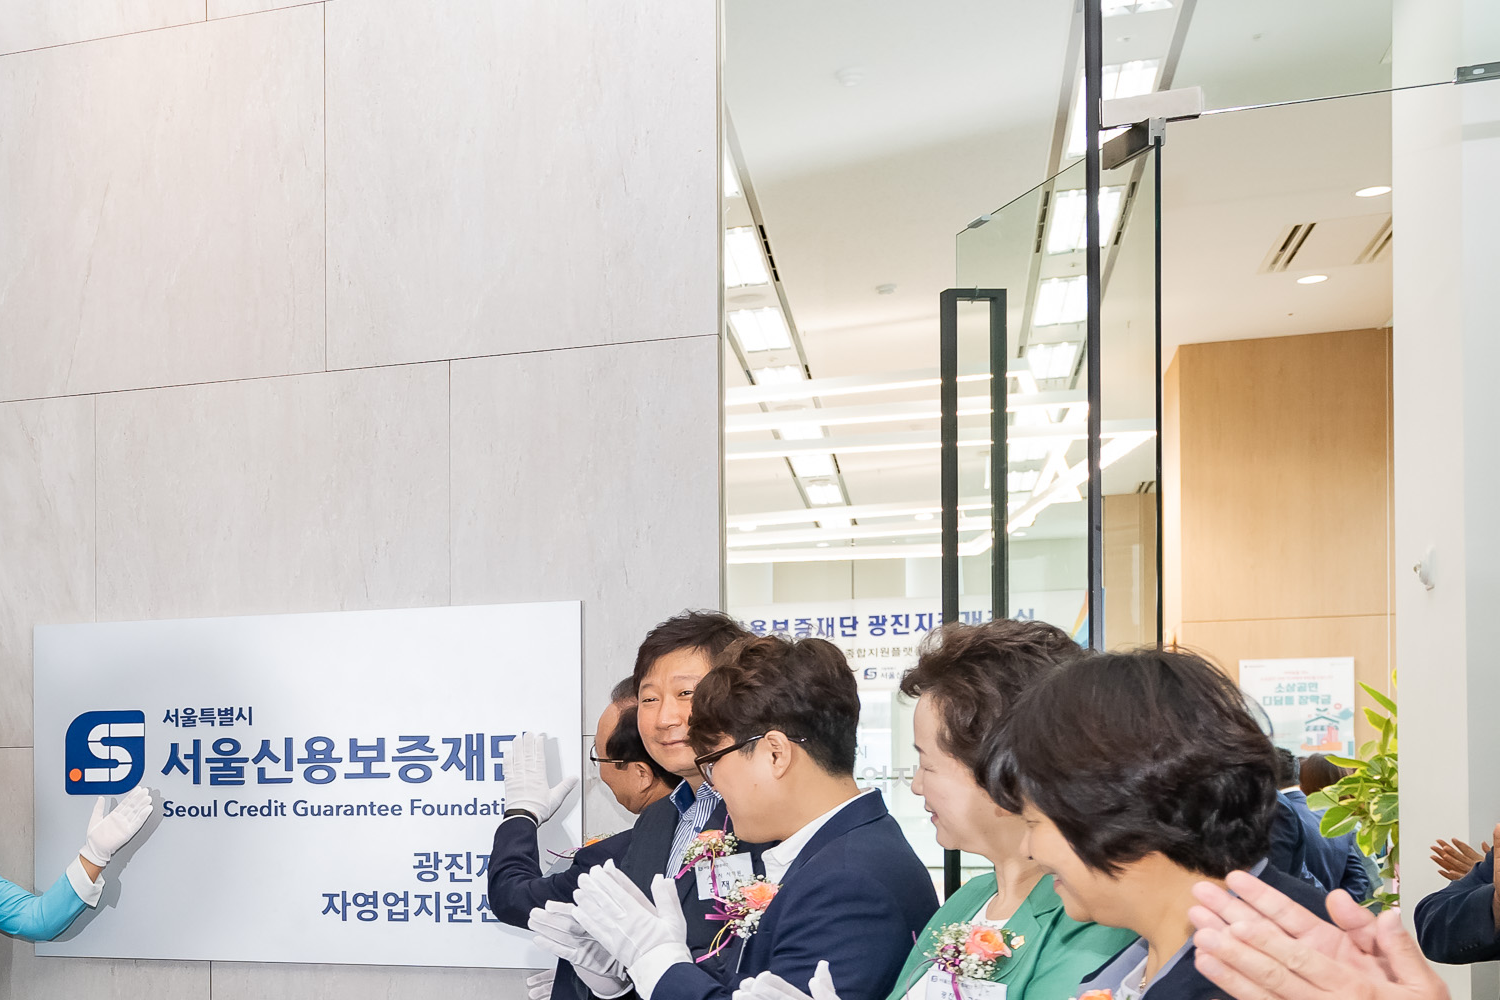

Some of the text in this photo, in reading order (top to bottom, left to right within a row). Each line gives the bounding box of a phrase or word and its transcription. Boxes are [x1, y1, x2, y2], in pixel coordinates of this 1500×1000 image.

[867, 612, 942, 637] 광진지
[162, 706, 254, 728] 서울특별시
[163, 797, 506, 818] Seoul Credit Guarantee Foundati
